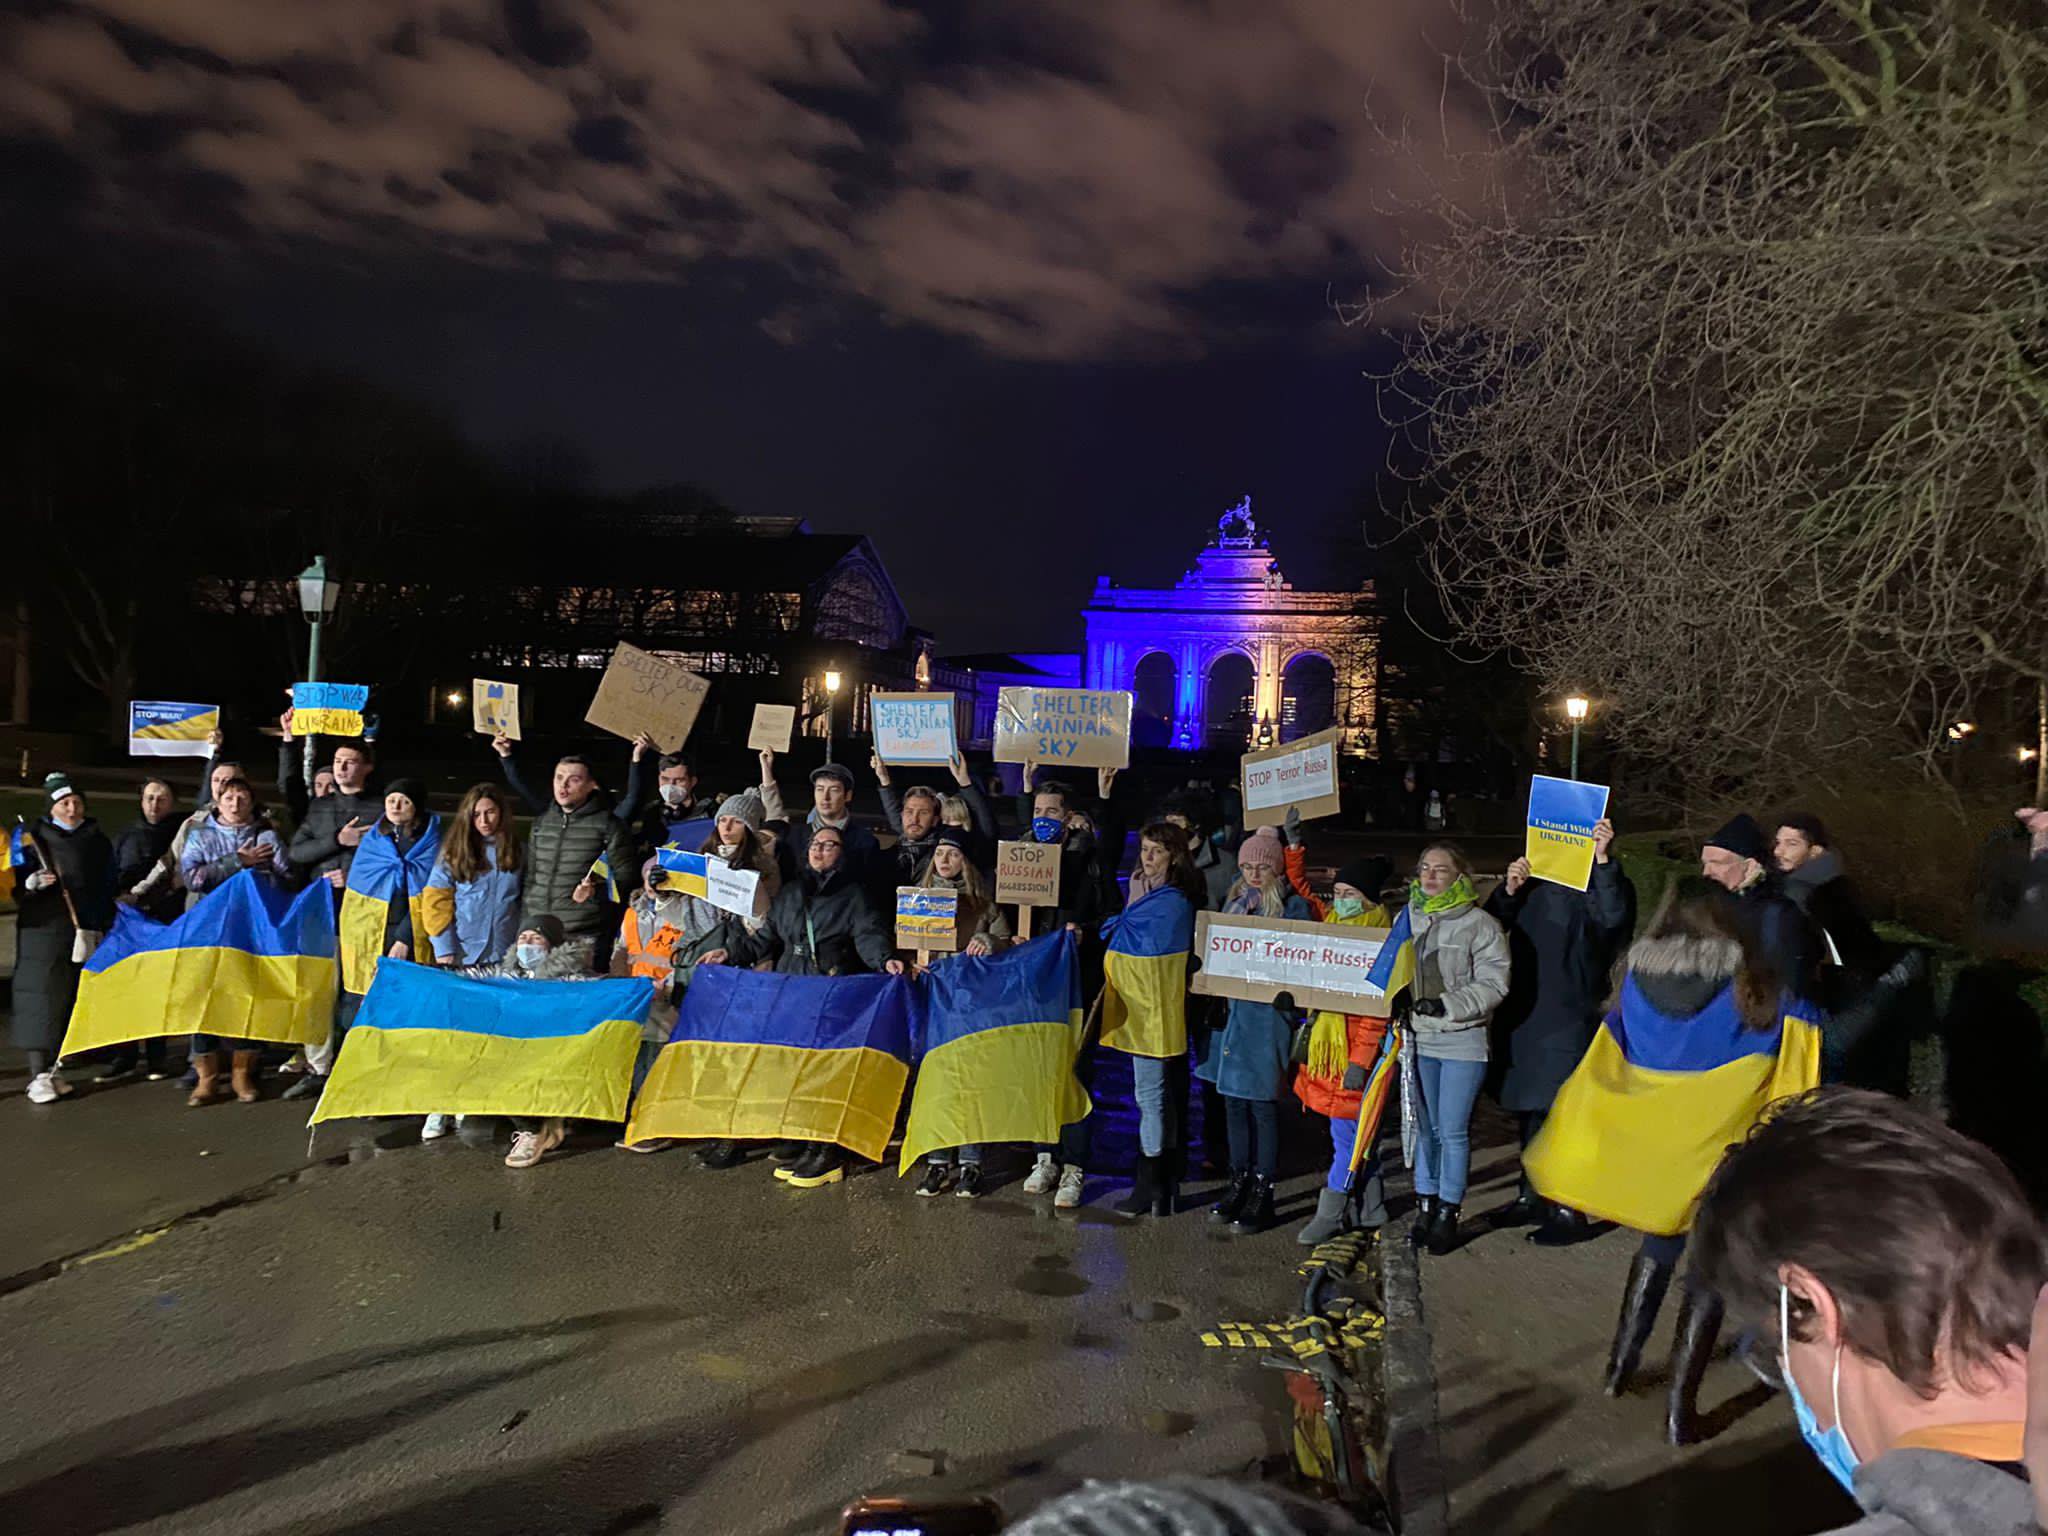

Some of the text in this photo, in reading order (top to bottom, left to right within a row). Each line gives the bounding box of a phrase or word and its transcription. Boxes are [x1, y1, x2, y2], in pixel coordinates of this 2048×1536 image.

[620, 651, 704, 693] SHELTER OUR
[295, 686, 339, 705] STOP
[632, 675, 675, 704] SKY
[1031, 694, 1114, 716] SHELTER
[135, 711, 159, 719] STOP
[1038, 738, 1078, 757] SKY
[1248, 757, 1328, 788] STOP Terror Russia
[1535, 818, 1593, 835] I Stand With
[1540, 831, 1587, 848] UKRAINE
[1010, 847, 1045, 863] STOP
[1000, 864, 1054, 879] RUSSIAN
[1211, 937, 1376, 969] STOP Terror Russia
